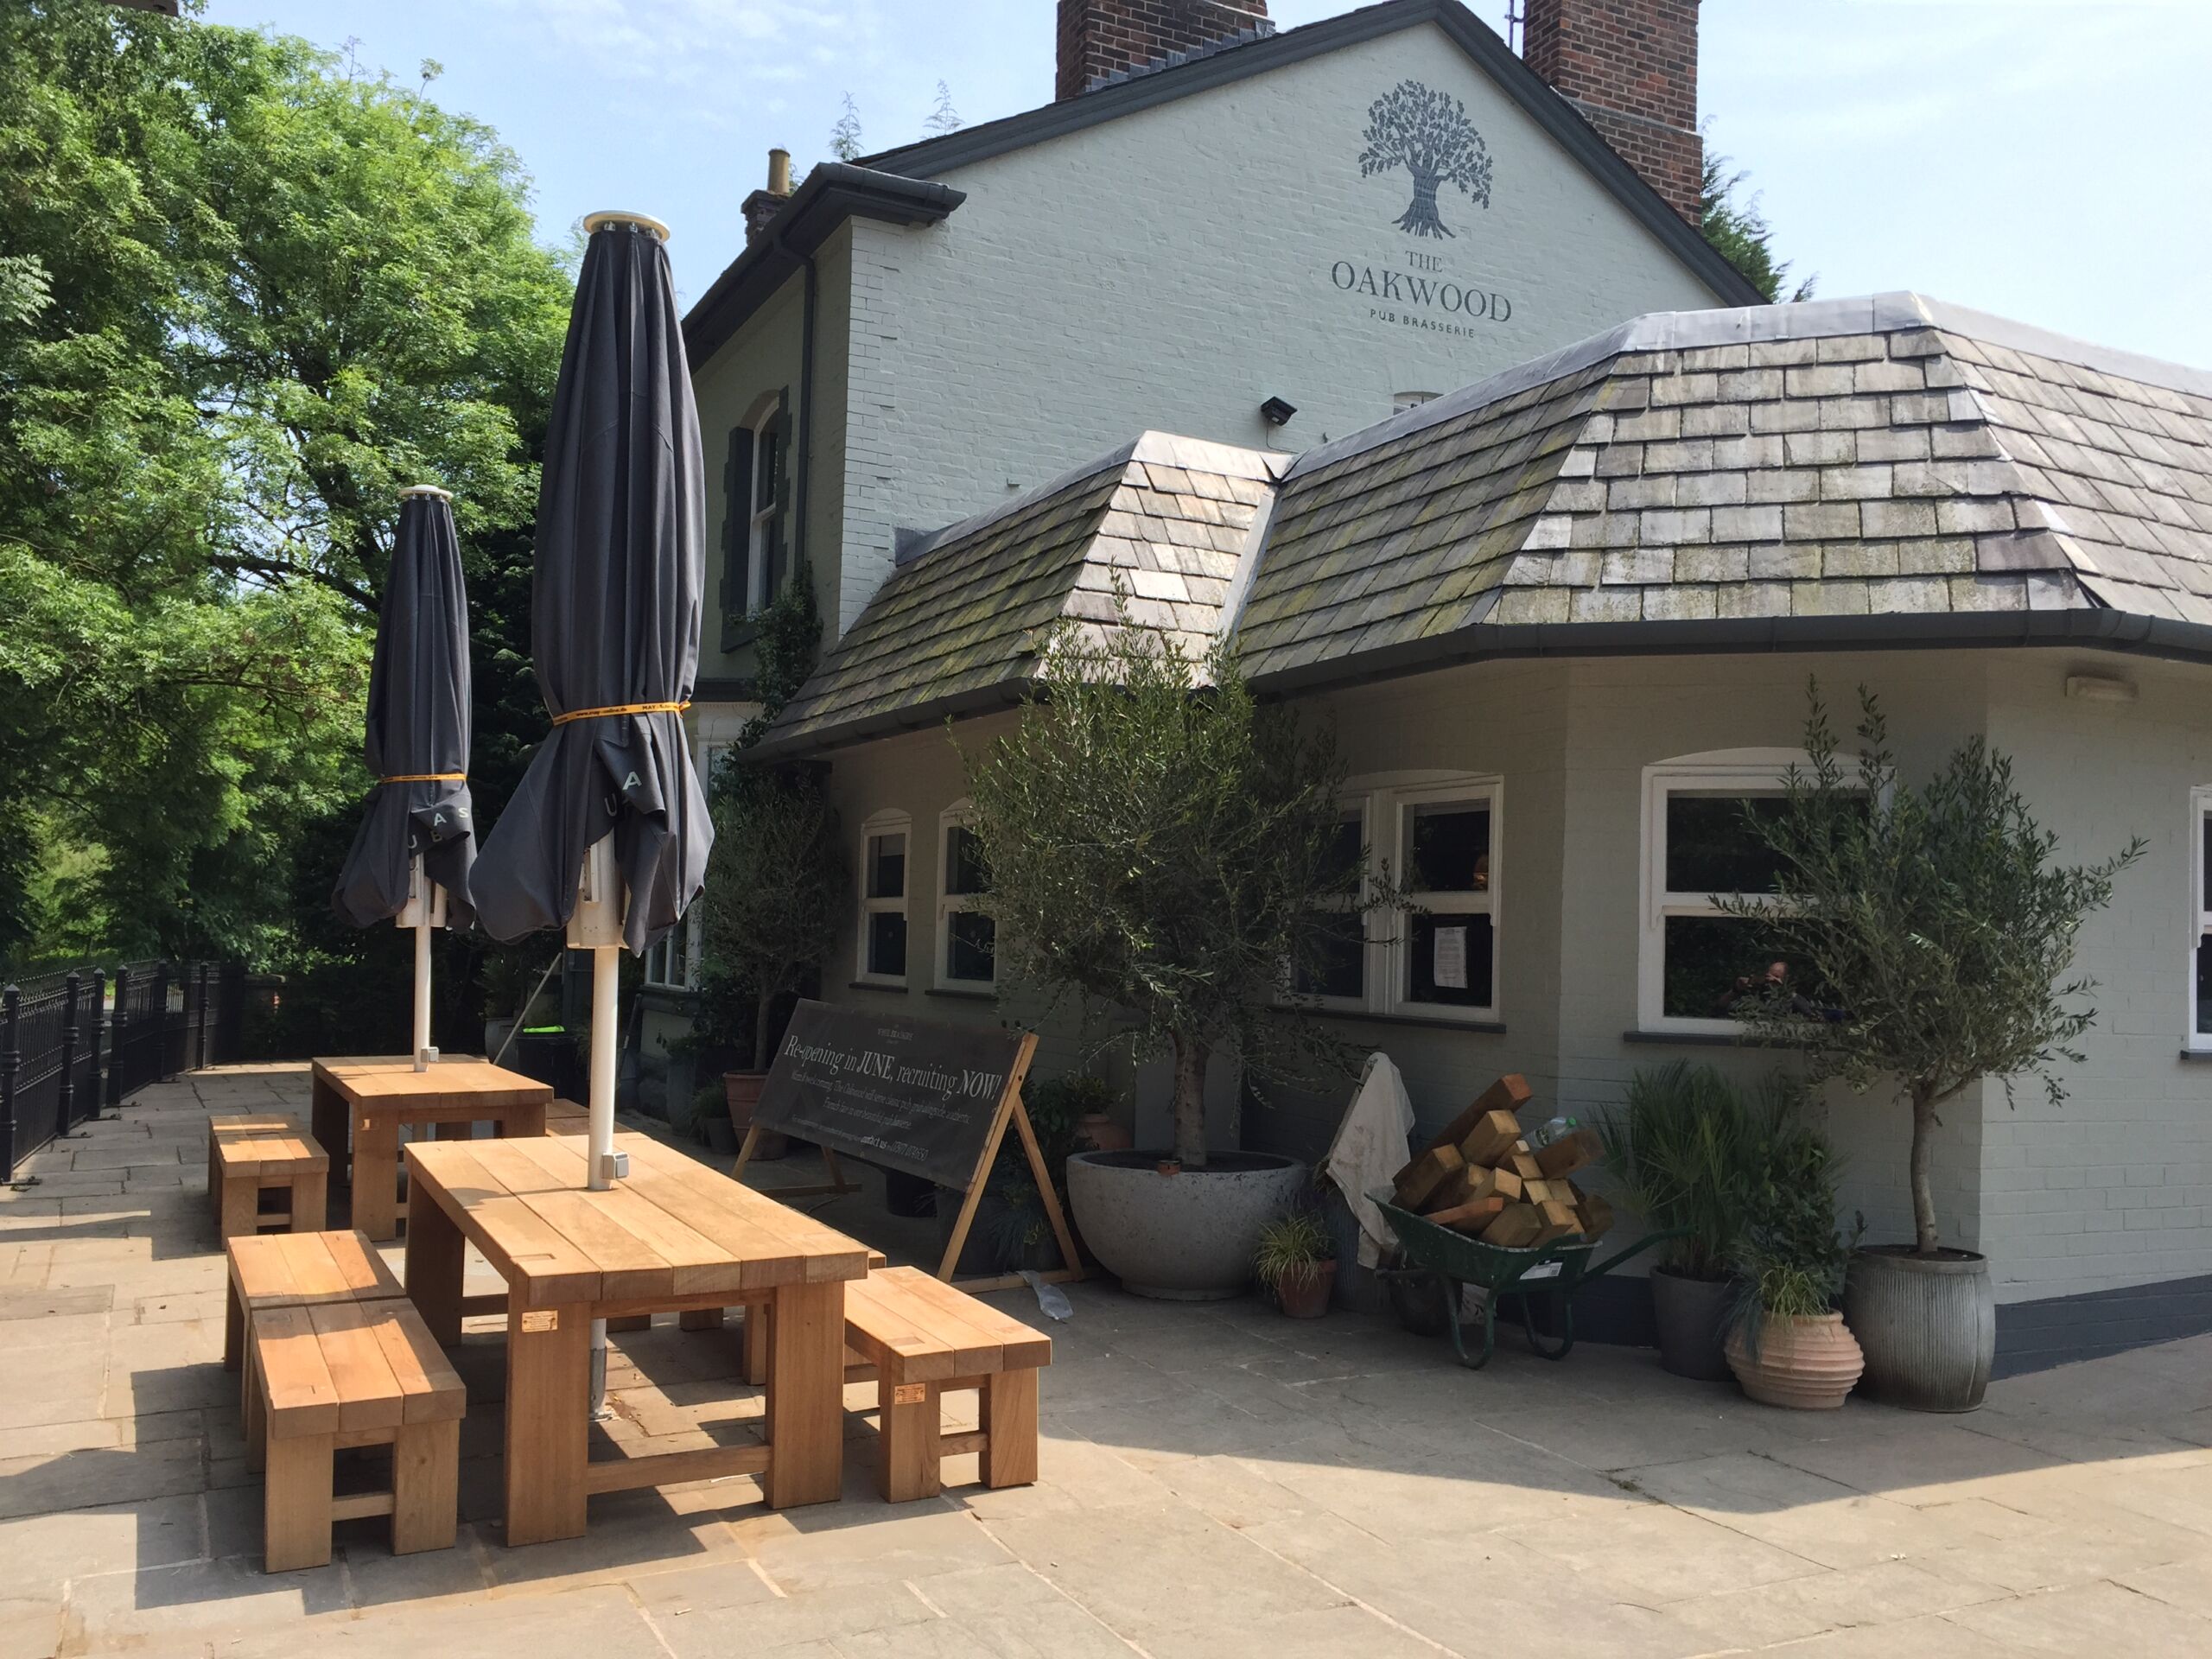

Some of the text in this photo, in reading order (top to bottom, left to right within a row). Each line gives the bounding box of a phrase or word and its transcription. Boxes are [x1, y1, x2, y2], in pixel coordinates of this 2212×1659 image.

[1405, 250, 1443, 273] THE
[1331, 261, 1512, 322] OAKWOOD
[1370, 308, 1475, 338] PUB BRASSERIE
[784, 1035, 1002, 1102] Re-opening in JUNE, recruiting NOW!
